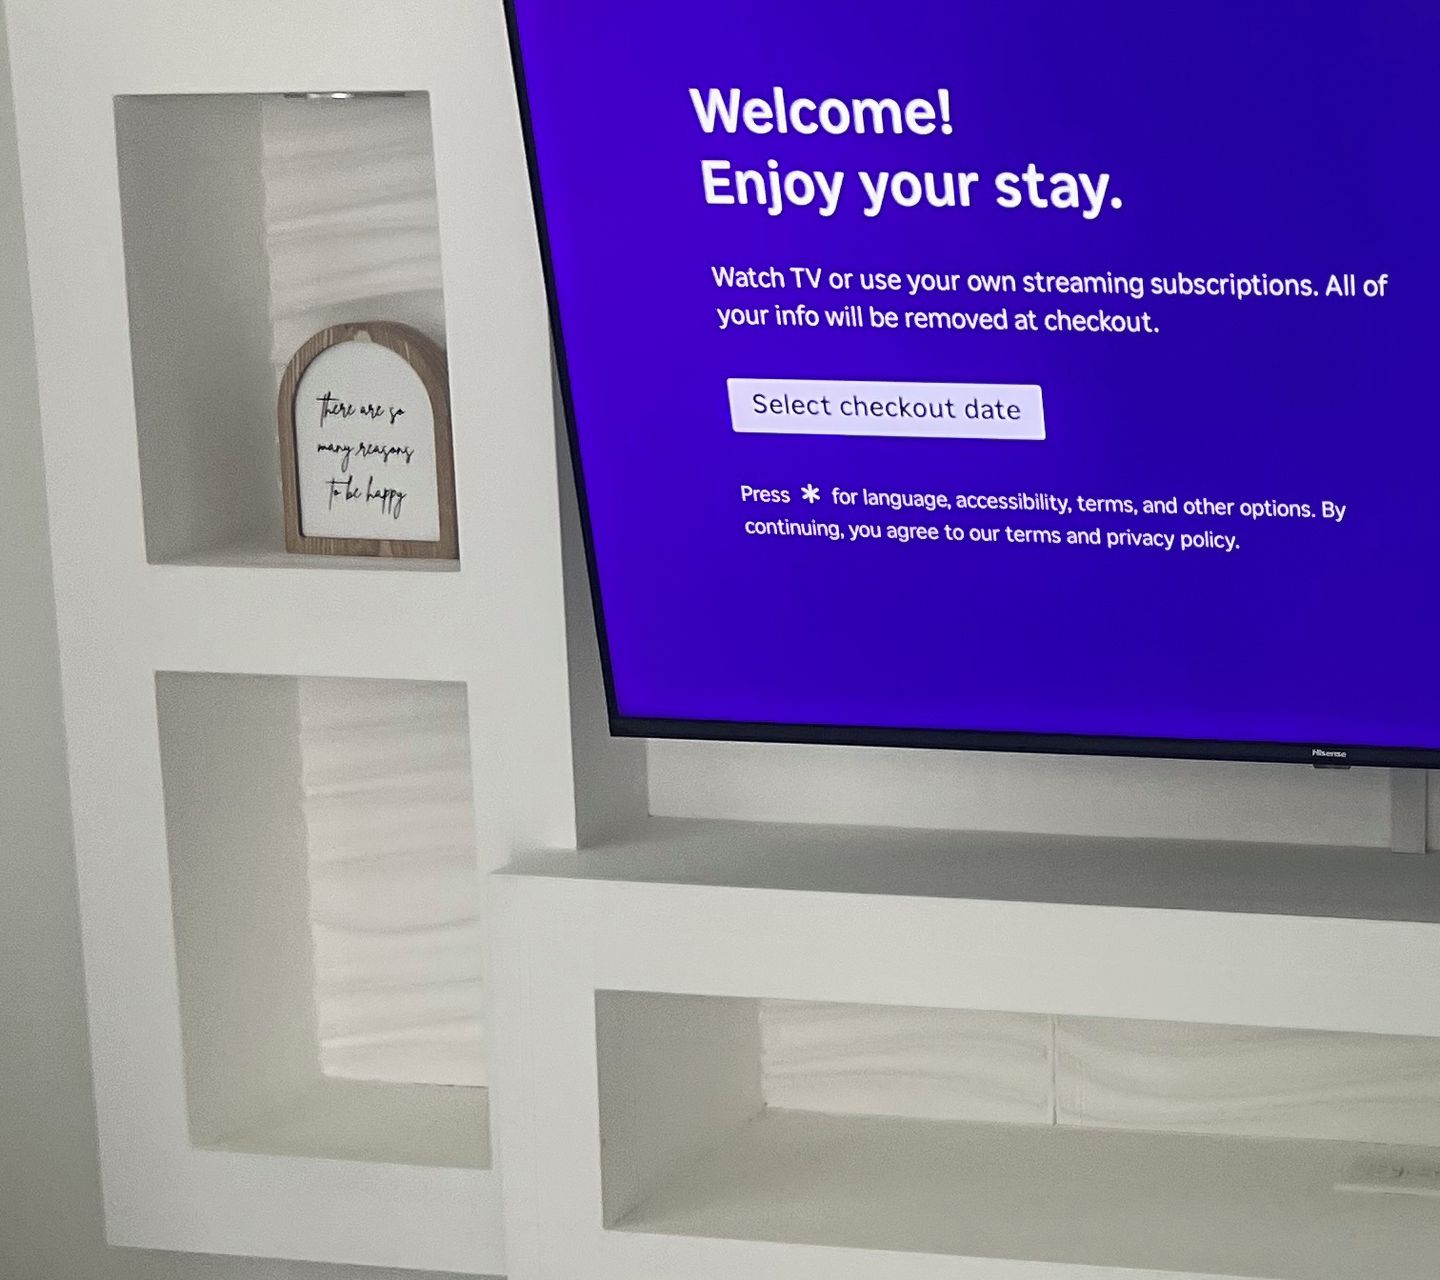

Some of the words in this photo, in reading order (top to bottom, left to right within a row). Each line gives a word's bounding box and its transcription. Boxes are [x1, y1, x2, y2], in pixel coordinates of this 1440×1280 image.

[688, 86, 953, 135] Welcome!
[700, 158, 845, 217] Enjoy
[857, 170, 979, 218] your
[994, 163, 1123, 220] stay.
[711, 266, 786, 289] Watch
[789, 267, 822, 289] TV
[828, 272, 854, 290] or
[859, 272, 902, 291] use
[906, 273, 961, 296] your
[967, 274, 1017, 292] own
[1022, 271, 1145, 300] streaming
[1150, 272, 1319, 301] subscriptions.
[1325, 273, 1356, 297] All
[1363, 273, 1389, 297] of
[716, 306, 770, 330] your
[774, 303, 820, 327] info
[824, 305, 864, 328] will
[869, 305, 899, 329] be
[904, 308, 1009, 331] removed
[1014, 309, 1039, 331] at
[1044, 309, 1160, 333] checkout.
[316, 391, 356, 428] there
[360, 404, 384, 419] are
[389, 404, 405, 424] so
[752, 392, 832, 417] Select
[840, 395, 957, 419] checkout
[964, 398, 1021, 421] date
[317, 442, 353, 472] many
[354, 440, 414, 464] reasons
[345, 475, 361, 500] be
[365, 475, 406, 519] happy
[740, 485, 791, 504] Press
[831, 486, 859, 505] for
[862, 487, 952, 512] language,
[955, 492, 1073, 515] accessibility,
[1076, 495, 1139, 516] terms,
[1142, 496, 1178, 515] and
[1183, 497, 1235, 516] other
[1239, 499, 1316, 522] options.
[1321, 500, 1347, 523] By
[744, 518, 845, 541] continuing,
[848, 524, 882, 542] you
[886, 525, 939, 543] agree
[943, 524, 965, 541] to
[969, 527, 1001, 542] our
[1004, 526, 1062, 544] terms
[1066, 527, 1102, 545] and
[1106, 528, 1175, 551] privacy
[1180, 530, 1240, 553] policy.
[1312, 749, 1347, 758] Hisense
